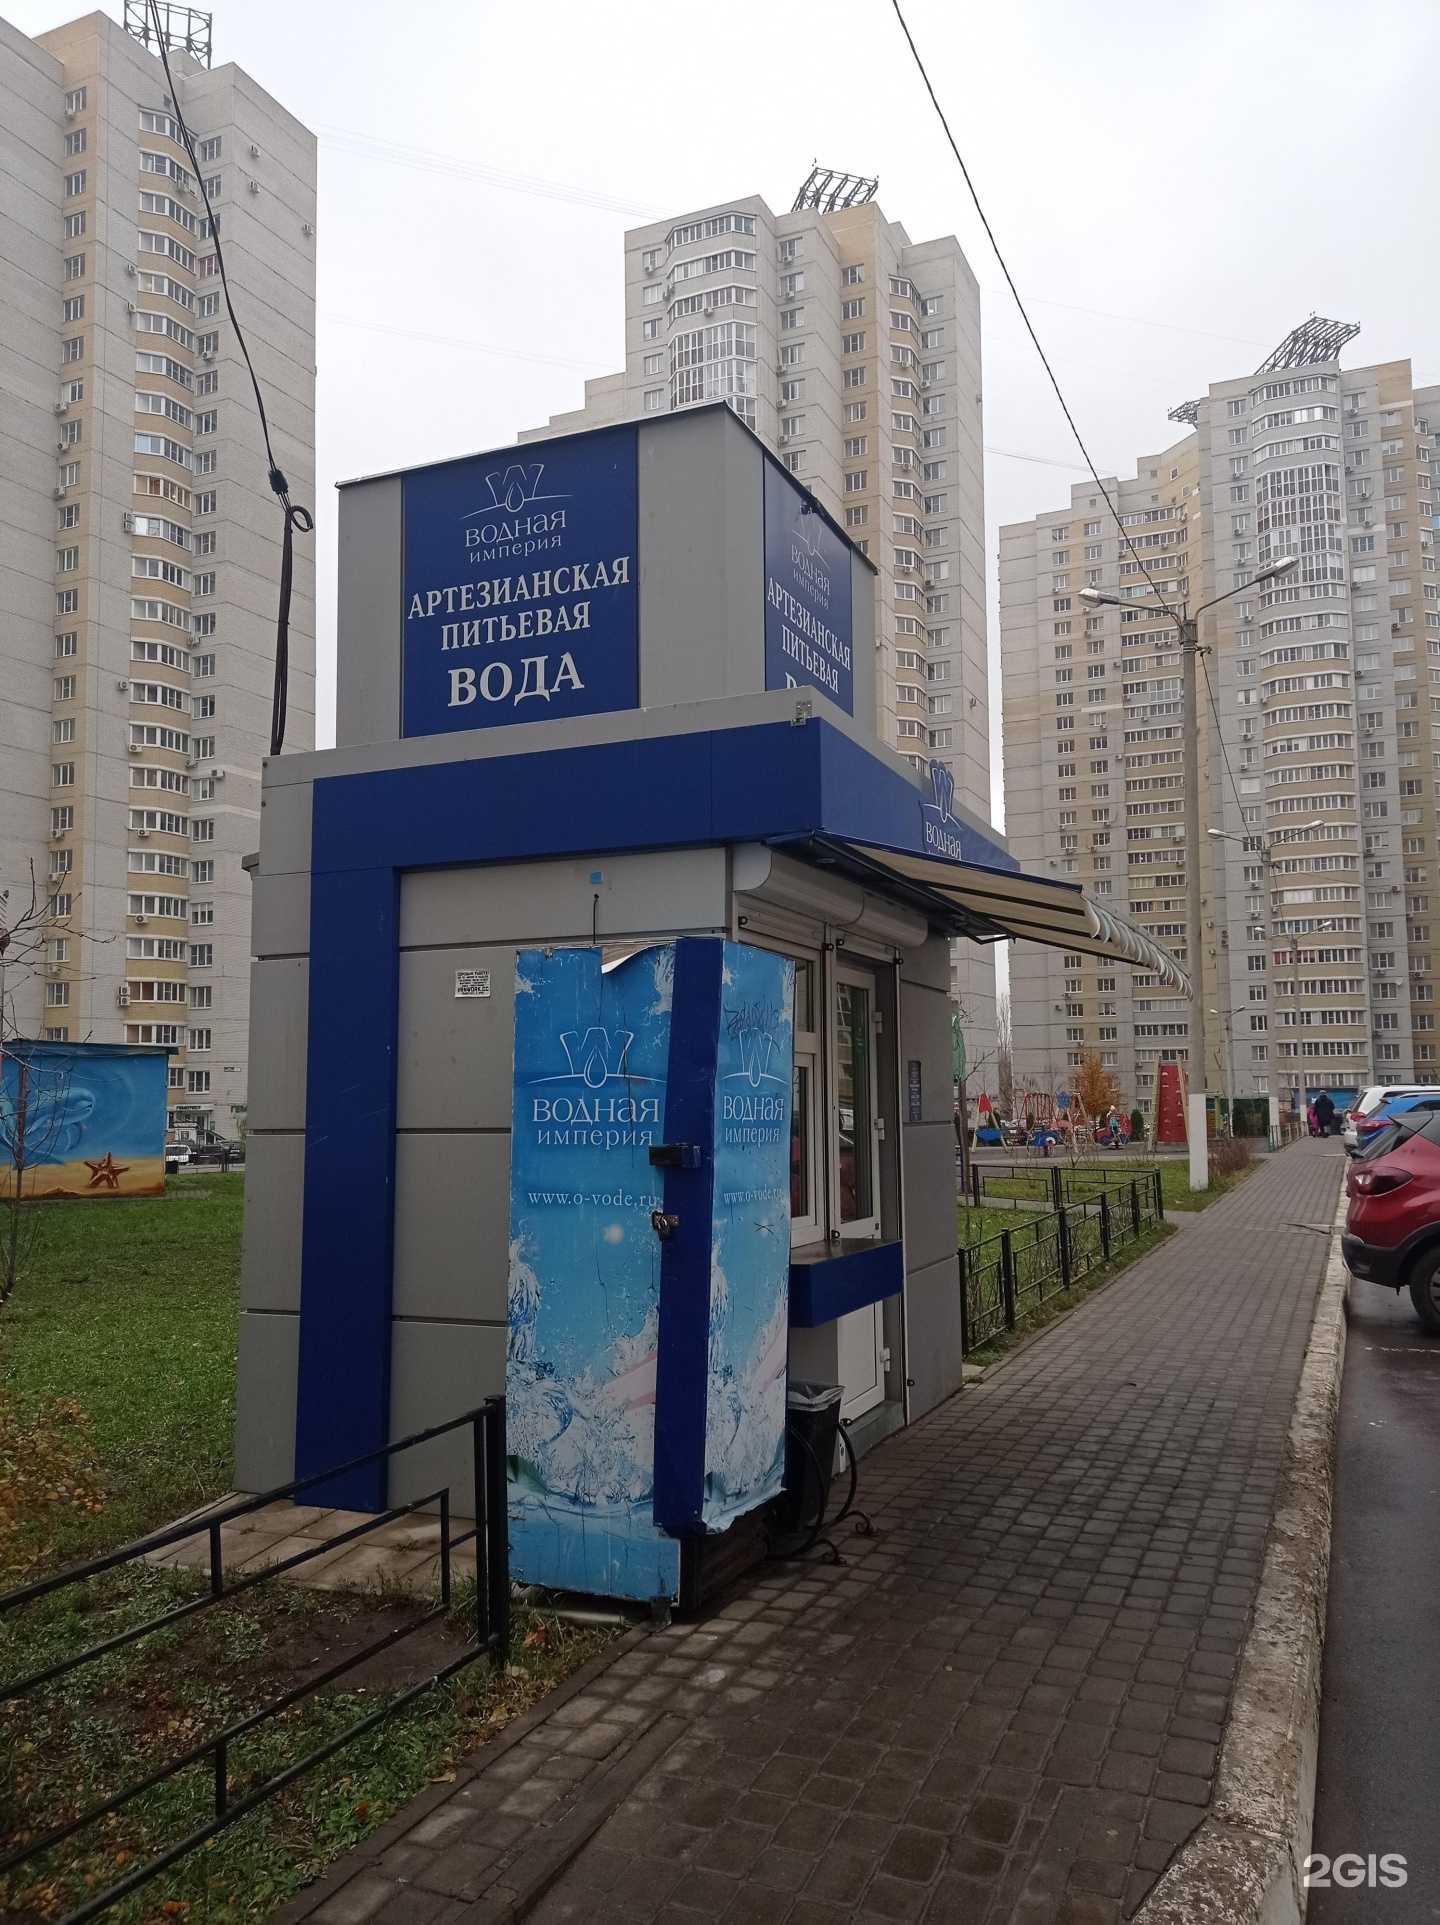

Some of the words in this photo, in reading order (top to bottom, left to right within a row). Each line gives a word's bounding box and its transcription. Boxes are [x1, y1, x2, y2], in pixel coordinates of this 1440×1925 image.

[469, 534, 562, 564] империя
[407, 556, 630, 620] АРТЕЗИАНСКАЯ
[440, 600, 592, 651] ПИТЬЕВАЯ
[767, 577, 852, 673] АРТЕЗИАНСКАЯ
[447, 651, 585, 707] ВОДА
[781, 624, 840, 695] ПИТЬЕВАЯ
[537, 1127, 656, 1150] империя
[725, 1127, 781, 1148] империя
[527, 1188, 658, 1208] www.o-vode.ru
